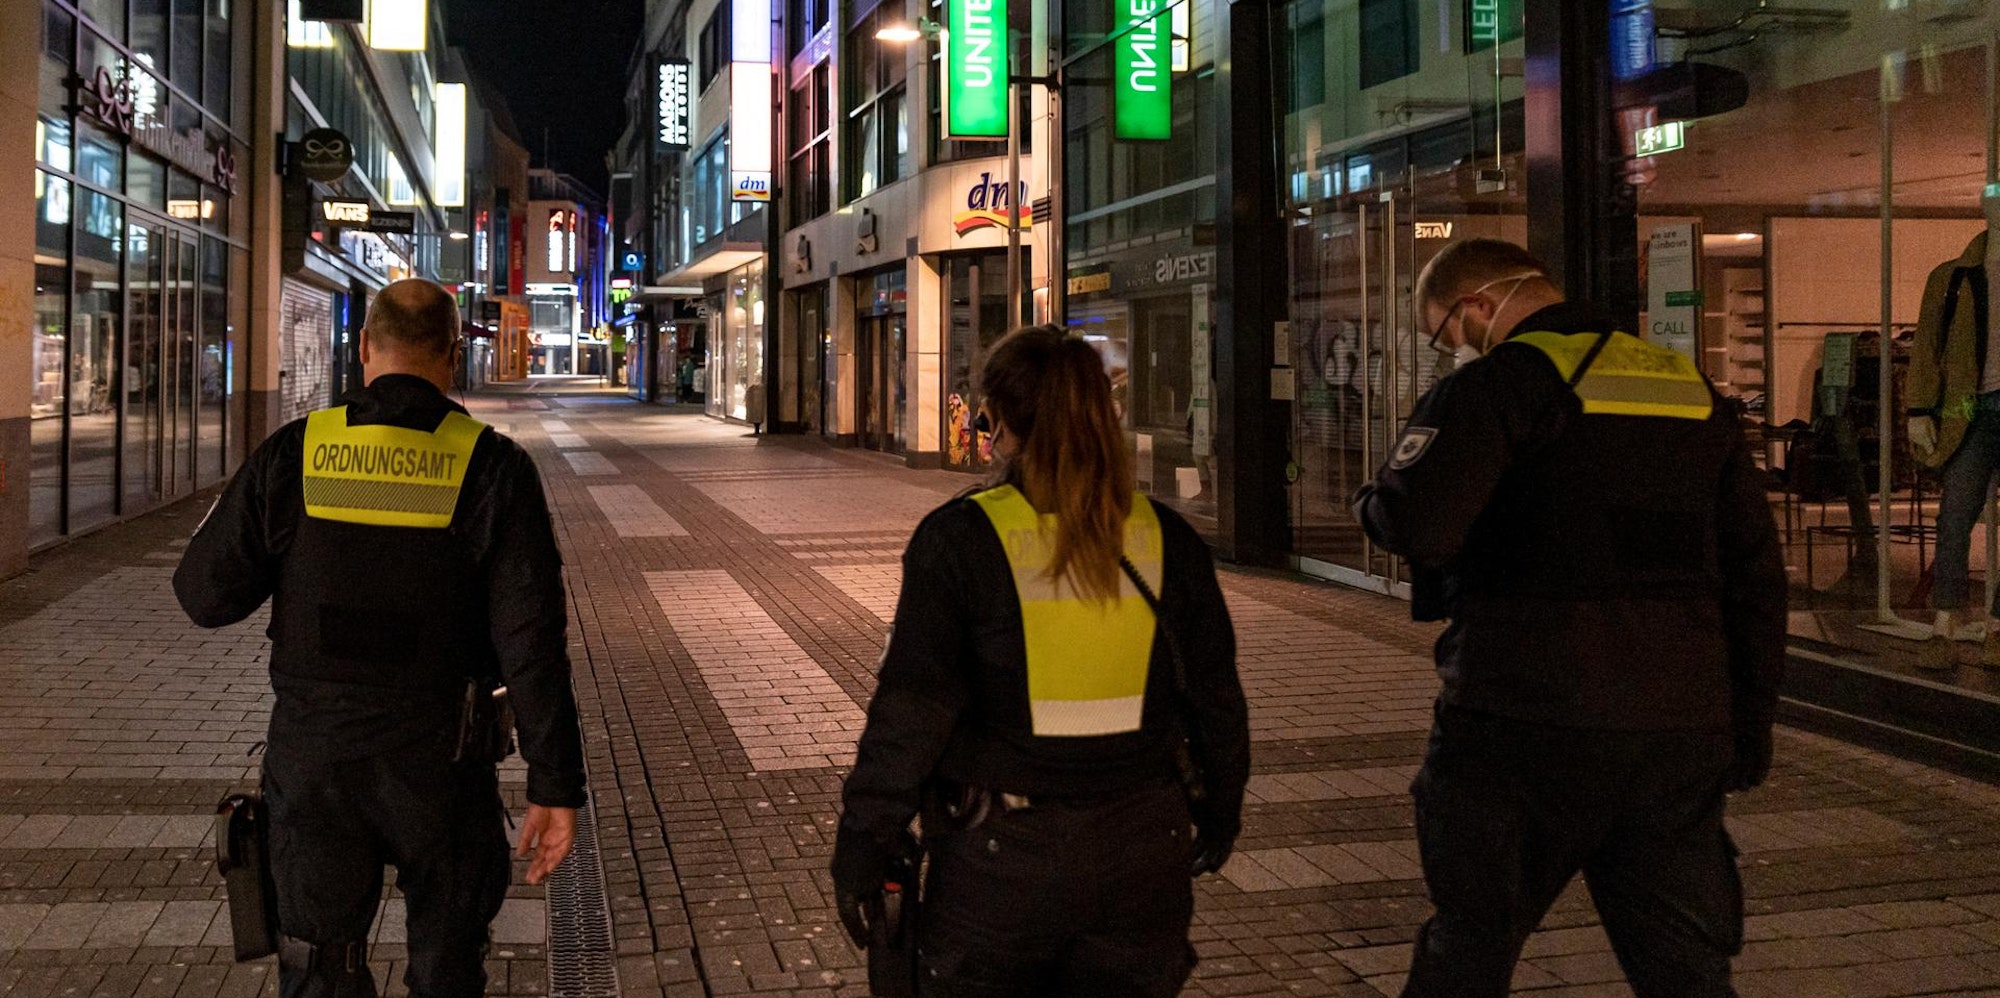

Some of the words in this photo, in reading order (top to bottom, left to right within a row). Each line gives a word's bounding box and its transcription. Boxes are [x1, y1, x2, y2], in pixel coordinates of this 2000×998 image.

[740, 176, 765, 190] dm
[968, 172, 1028, 209] dm
[323, 201, 370, 222] VANS
[1652, 321, 1689, 335] CALL
[313, 443, 457, 480] ORDNUNGSAMT
